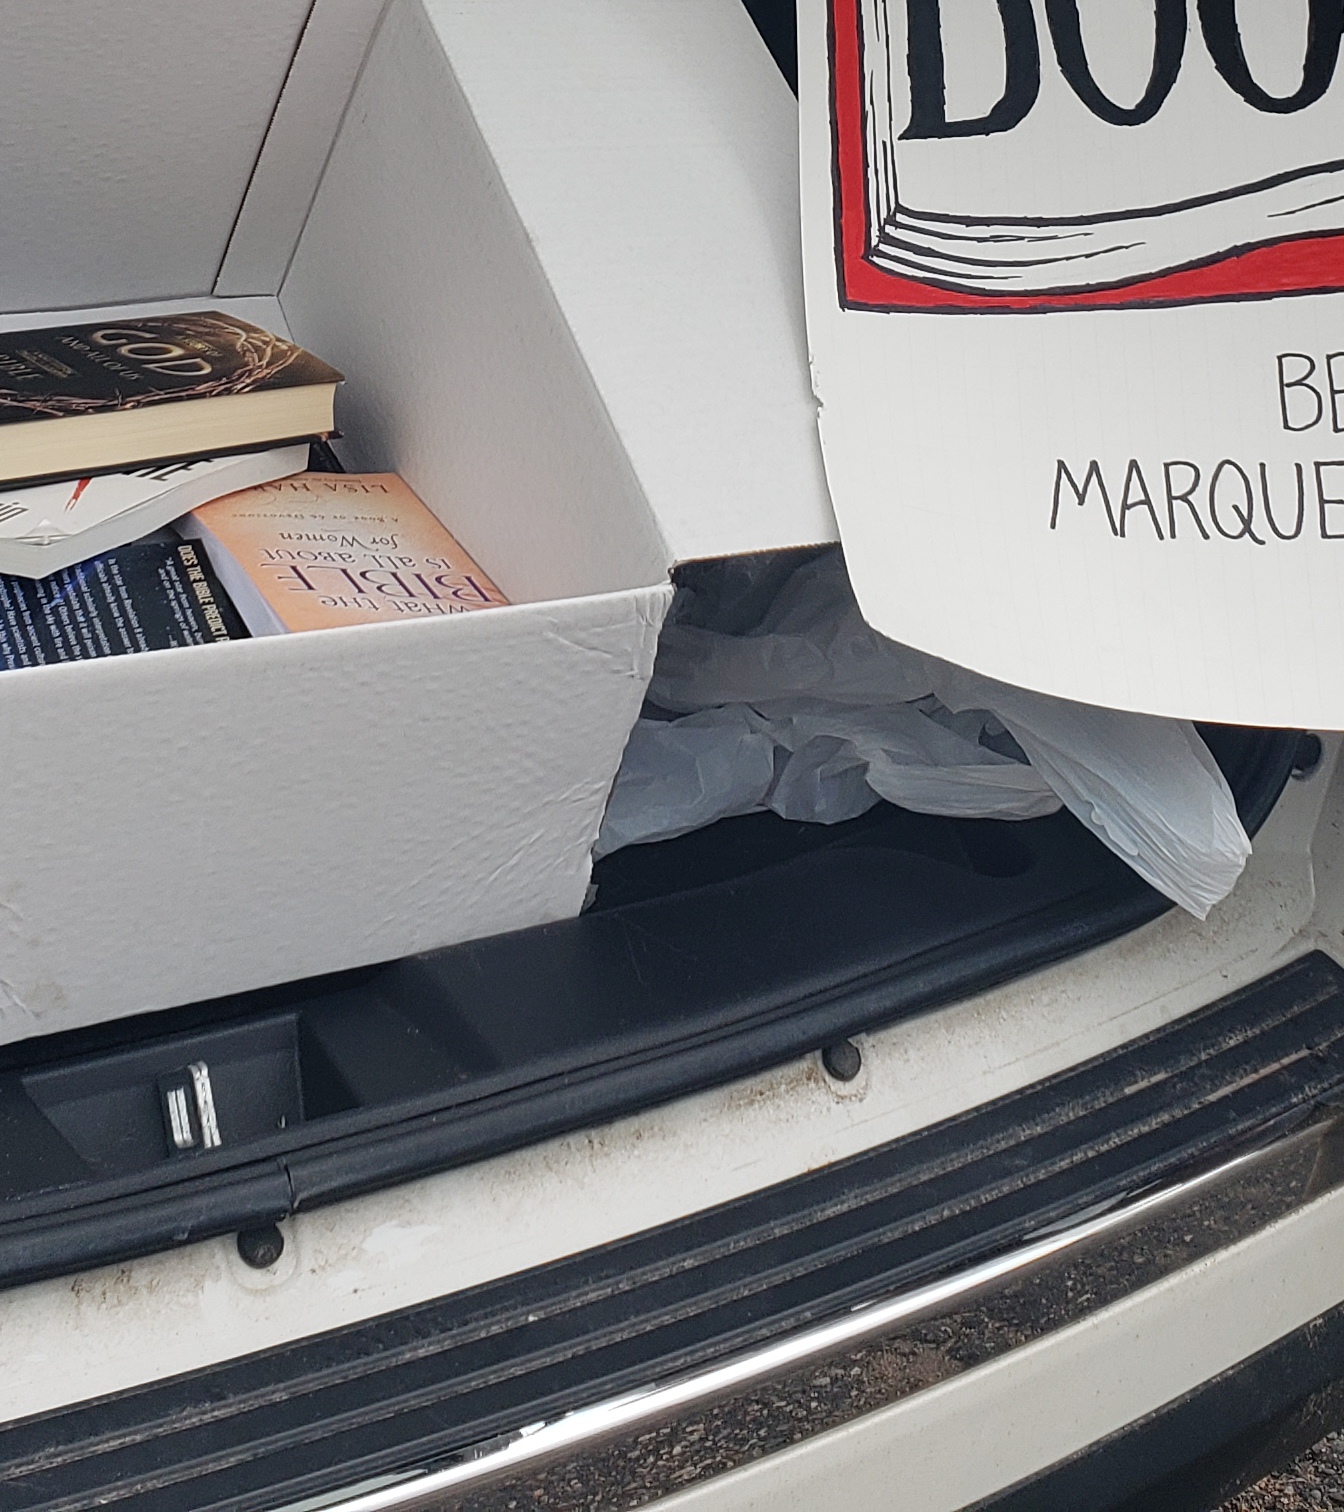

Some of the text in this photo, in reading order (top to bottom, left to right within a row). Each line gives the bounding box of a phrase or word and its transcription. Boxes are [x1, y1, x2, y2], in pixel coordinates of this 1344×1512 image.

[57, 337, 90, 350] AND
[93, 329, 212, 376] GOD
[324, 483, 388, 494] LISA
[278, 531, 399, 552] for Women
[178, 545, 225, 635] DOES THE BIBLE PREDICT
[260, 563, 492, 604] BIBLE
